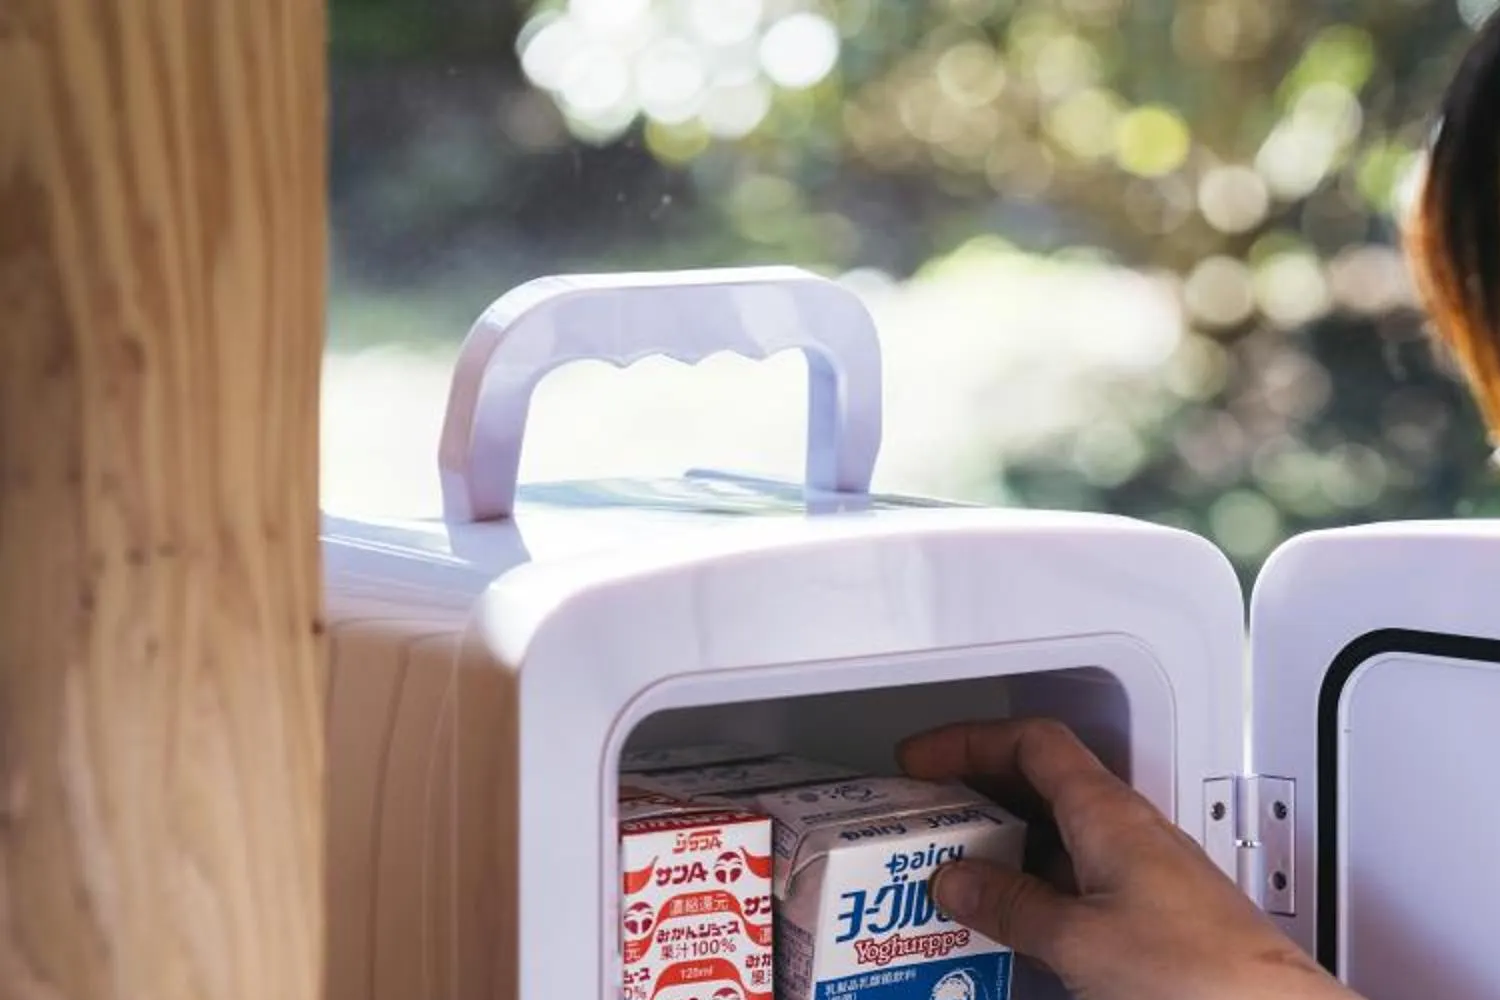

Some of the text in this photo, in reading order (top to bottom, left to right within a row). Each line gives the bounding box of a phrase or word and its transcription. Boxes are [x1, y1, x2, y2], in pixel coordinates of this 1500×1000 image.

[656, 862, 708, 887] サンA
[836, 874, 954, 943] ヨーグル
[656, 920, 740, 943] みかんジュース
[660, 937, 737, 961] 果汁100%
[854, 928, 970, 965] Yoghurppe
